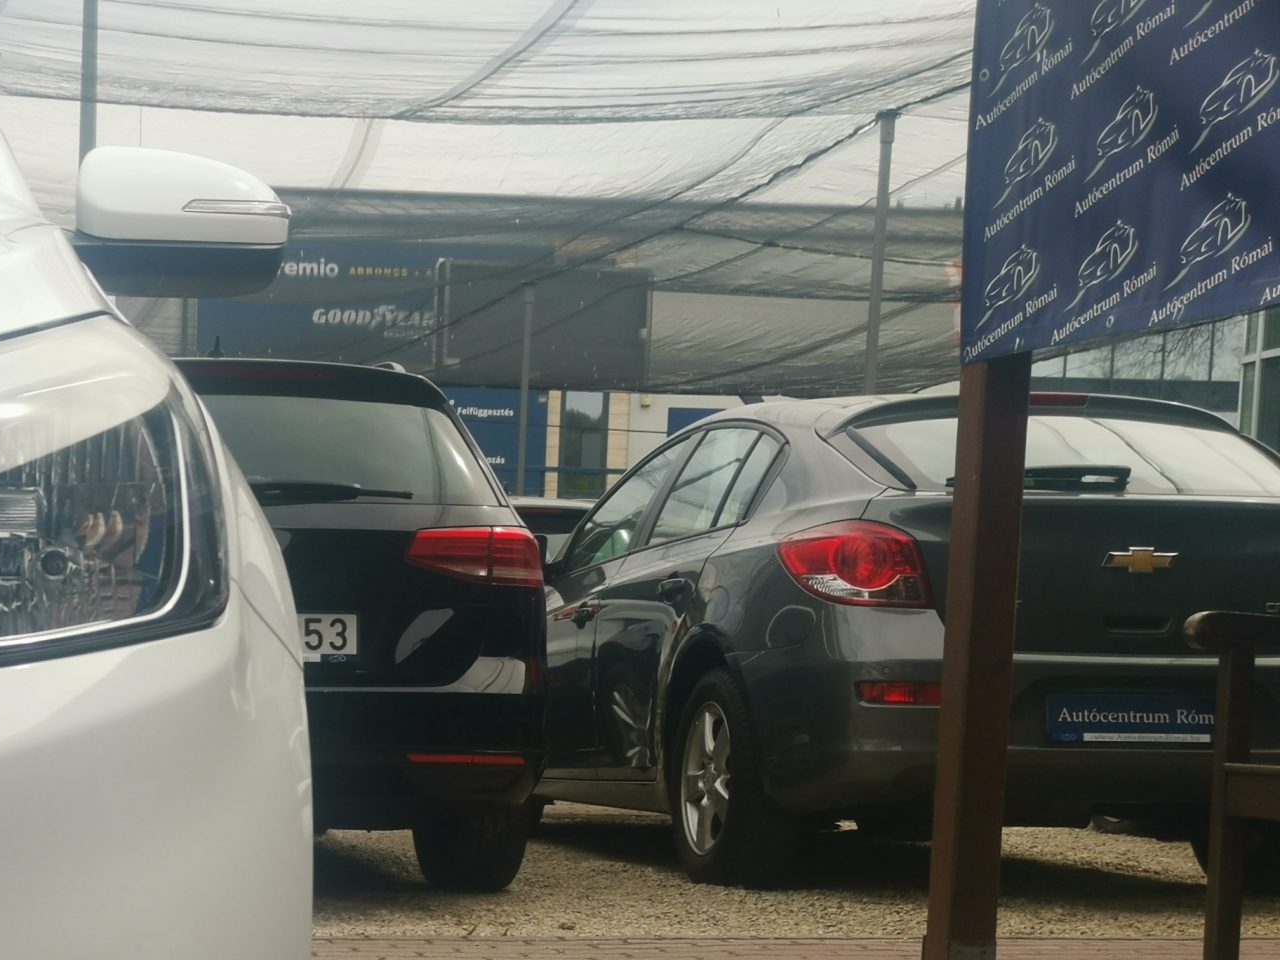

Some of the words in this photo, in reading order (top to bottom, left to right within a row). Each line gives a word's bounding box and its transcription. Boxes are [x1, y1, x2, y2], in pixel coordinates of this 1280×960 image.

[1070, 36, 1134, 101] Autócentrum
[1135, 0, 1175, 40] Római
[1169, 0, 1255, 67] Autócentrum
[975, 71, 1038, 131] Autócentrum
[1074, 158, 1144, 218] Autócentrum
[1146, 124, 1180, 163] Római
[1180, 126, 1252, 191] Autócentrum
[983, 187, 1043, 242] Autócentrum
[1044, 155, 1076, 192] Római
[1025, 283, 1058, 317] Római
[1051, 291, 1120, 346] Autócentrum
[1123, 261, 1157, 298] Római
[1148, 269, 1227, 327] Autócentrum
[1231, 236, 1273, 275] Római
[304, 617, 347, 651] 53
[1057, 707, 1170, 724] Autócentrum
[1176, 709, 1215, 725] Róm
